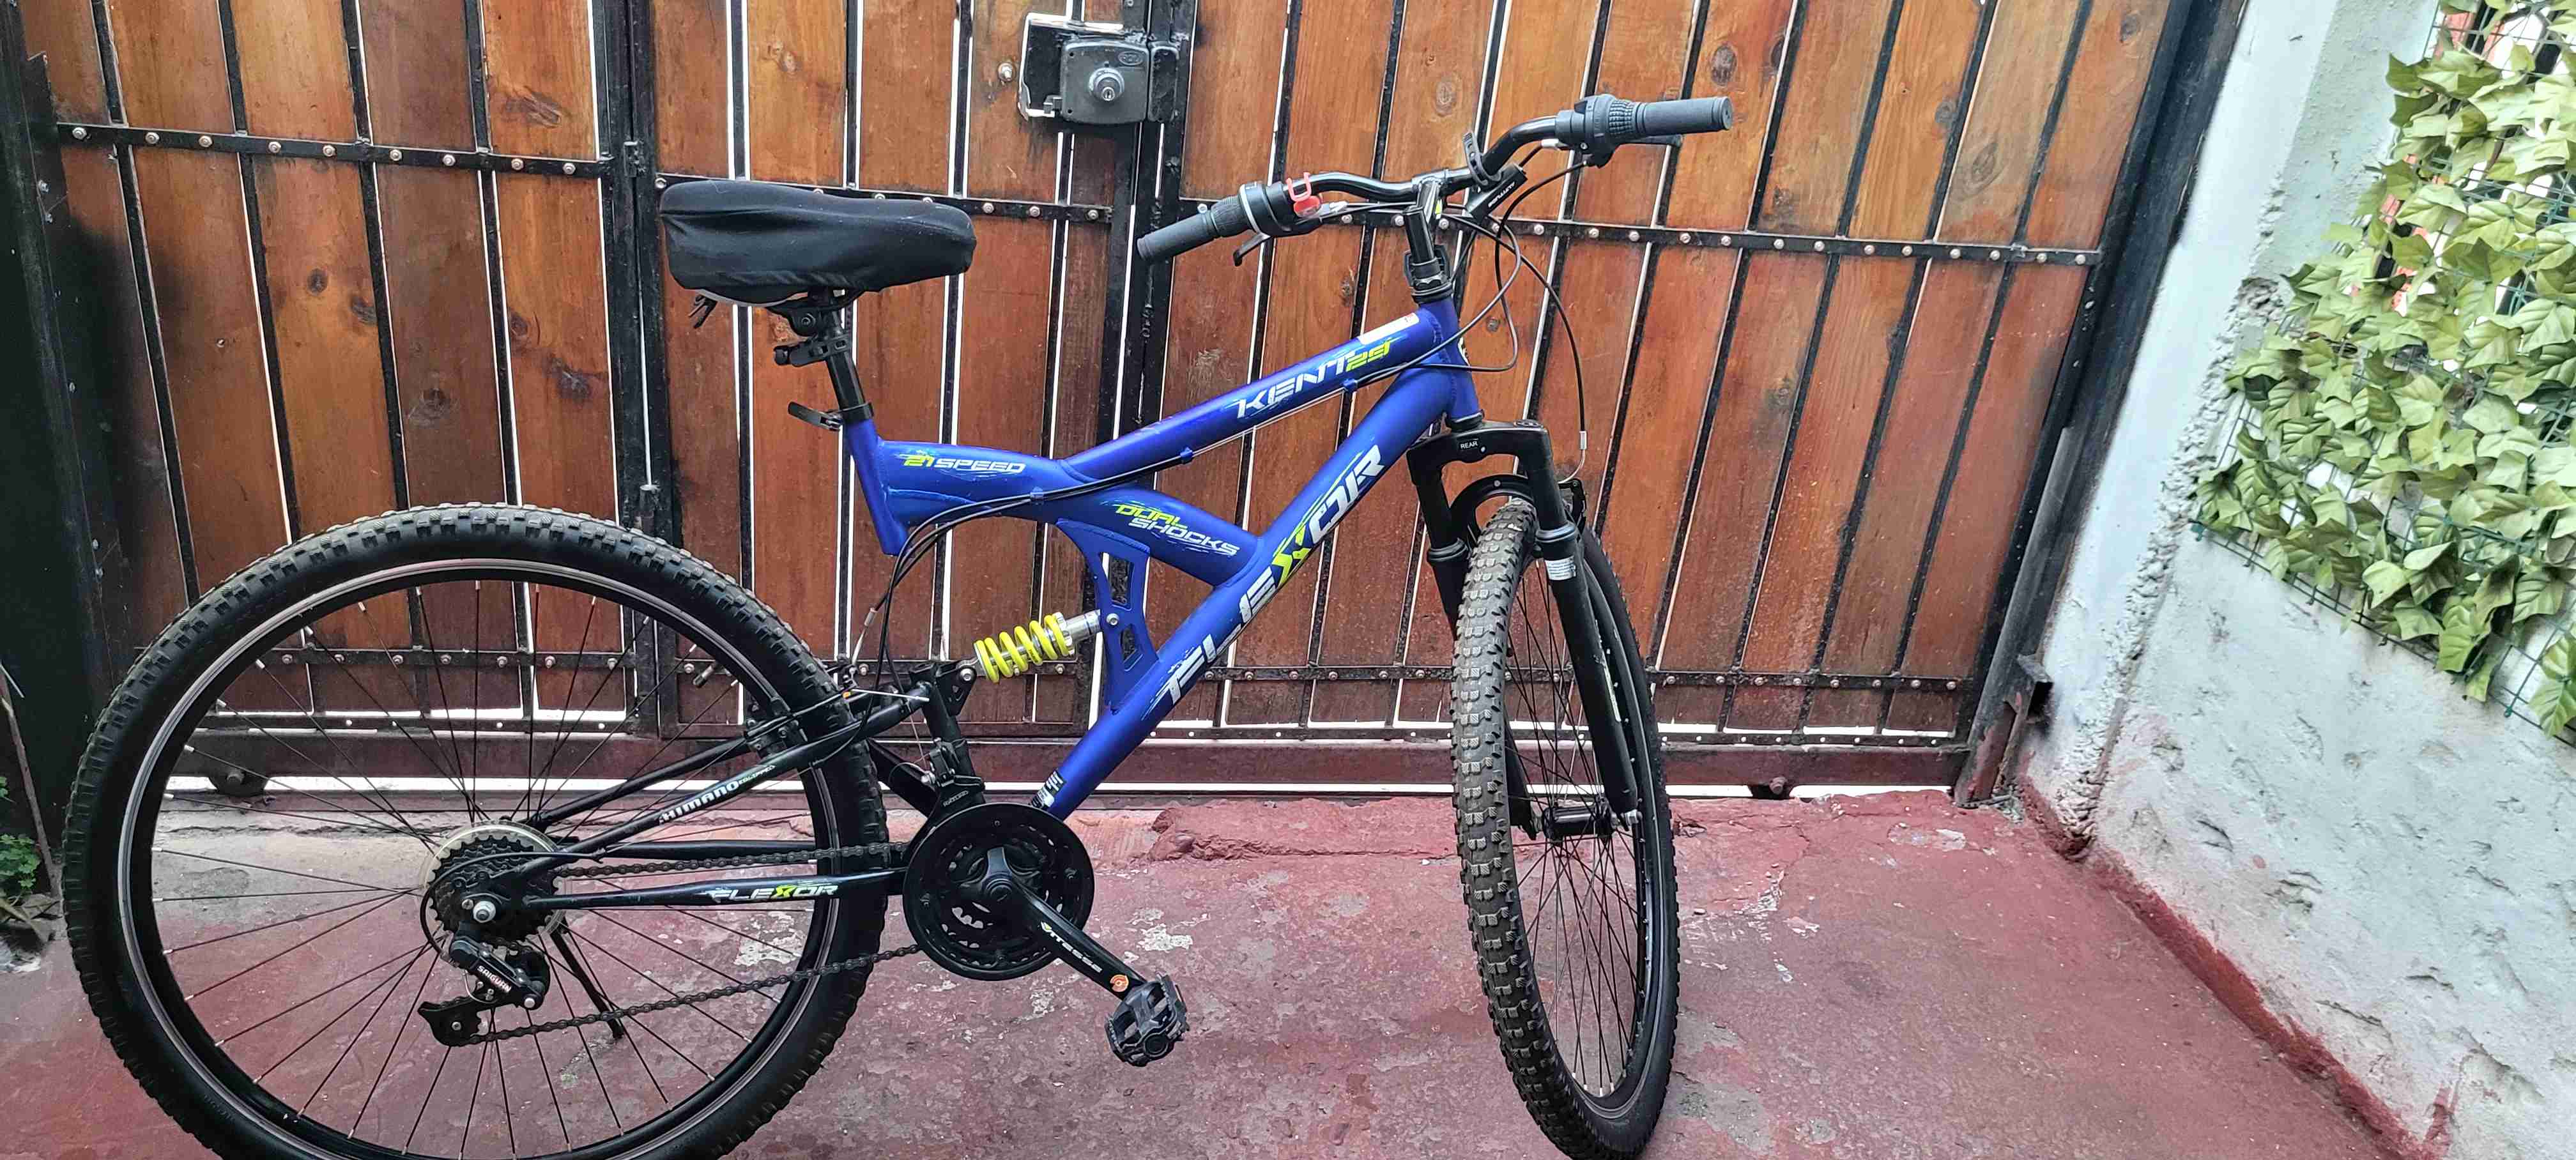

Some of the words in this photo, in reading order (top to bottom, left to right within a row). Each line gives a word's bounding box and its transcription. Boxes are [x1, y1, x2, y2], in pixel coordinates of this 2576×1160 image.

[1236, 351, 1354, 418] KENT
[1346, 339, 1390, 372] 29
[1460, 441, 1478, 449] REAR
[902, 455, 935, 468] 21
[934, 457, 1026, 474] SPEED
[1115, 503, 1188, 528] DUAL
[1128, 517, 1240, 556] SHOCKS
[1155, 444, 1386, 706] FLEXOR
[703, 884, 839, 903] FLEXOR
